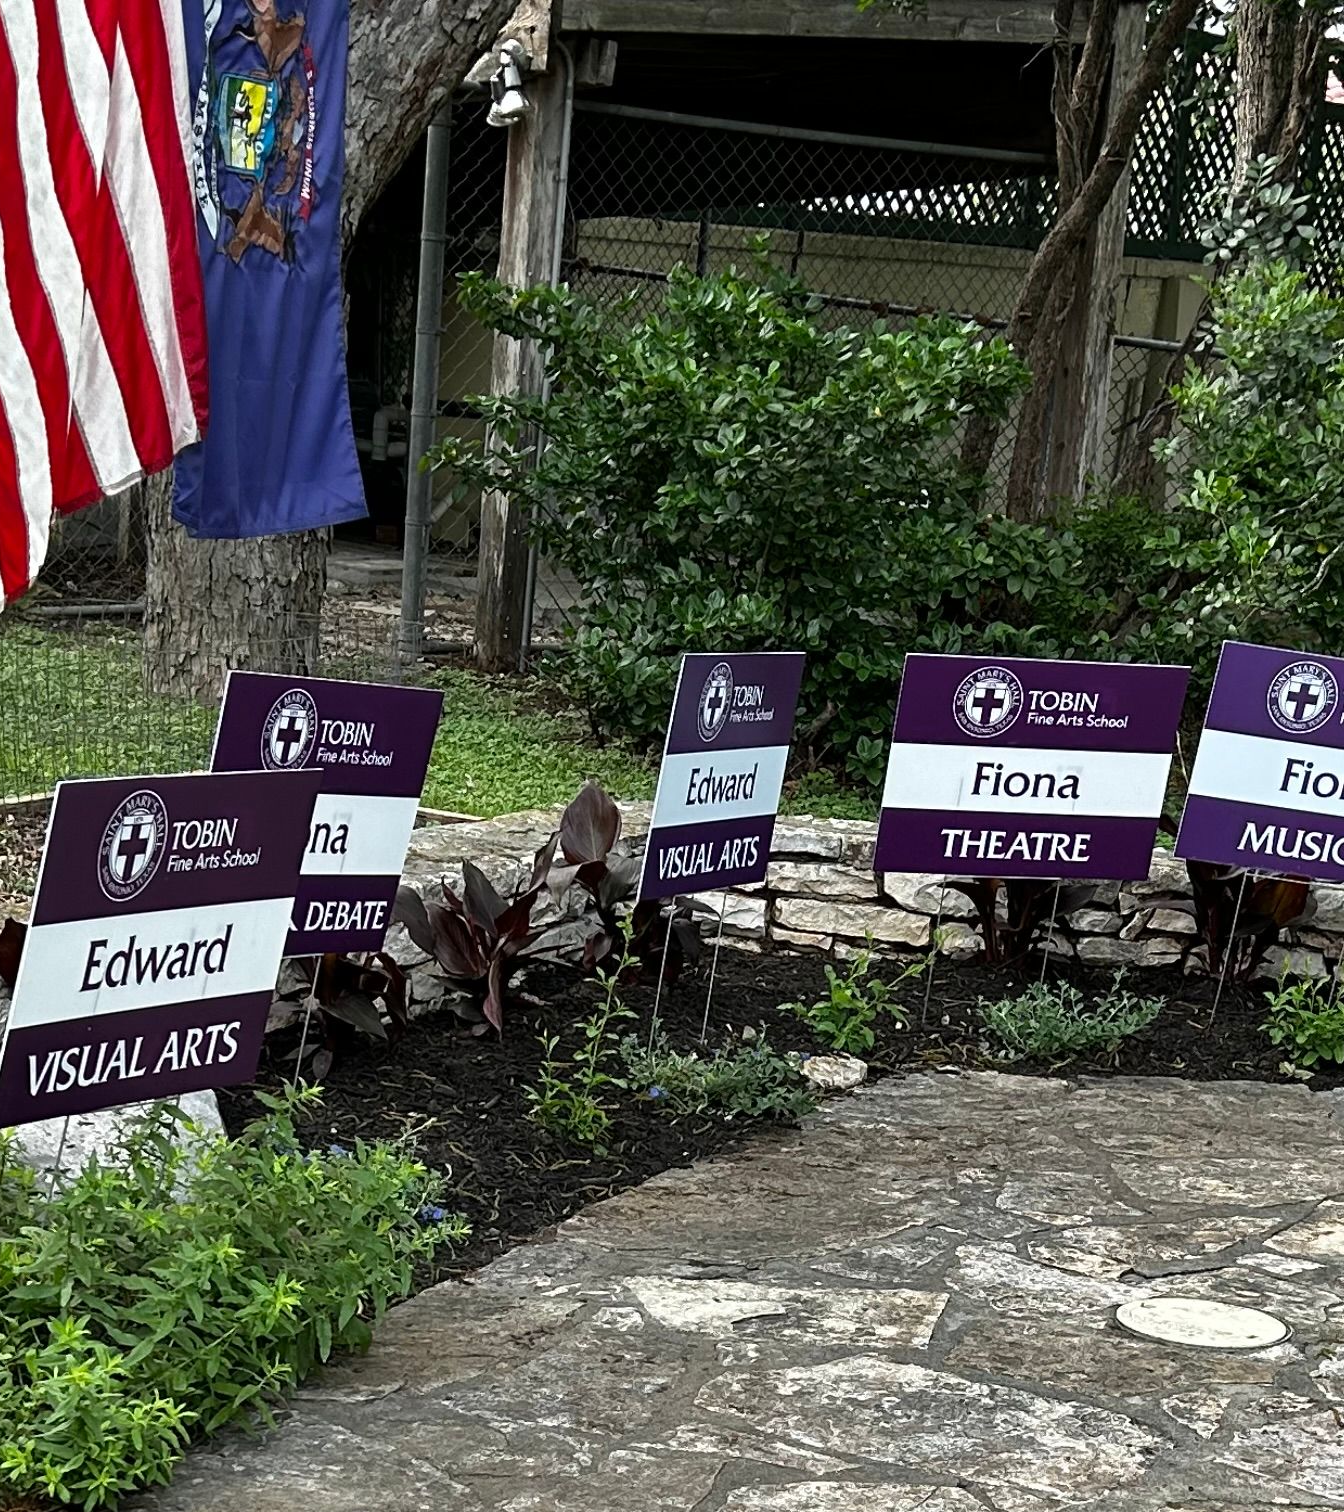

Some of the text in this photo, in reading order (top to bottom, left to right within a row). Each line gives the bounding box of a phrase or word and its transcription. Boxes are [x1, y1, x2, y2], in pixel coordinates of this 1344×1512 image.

[300, 158, 314, 200] UNUM
[733, 685, 765, 707] TOBIN
[1028, 690, 1099, 713] TOBIN
[320, 719, 376, 747] TOBIN
[1027, 711, 1129, 729] Fine Arts School
[316, 746, 338, 764] Fine
[338, 748, 361, 765] Arts
[360, 749, 395, 767] School
[685, 762, 759, 806] Edward
[971, 761, 1081, 800] Fiona
[172, 817, 239, 851] TOBIN
[941, 828, 1092, 862] THEATRE
[167, 846, 262, 873] Fine Arts School
[659, 835, 760, 881] VISUAL ARTS
[304, 901, 388, 931] DEBATE
[79, 923, 234, 993] Edward
[28, 1021, 241, 1097] VISUAL ARTS
